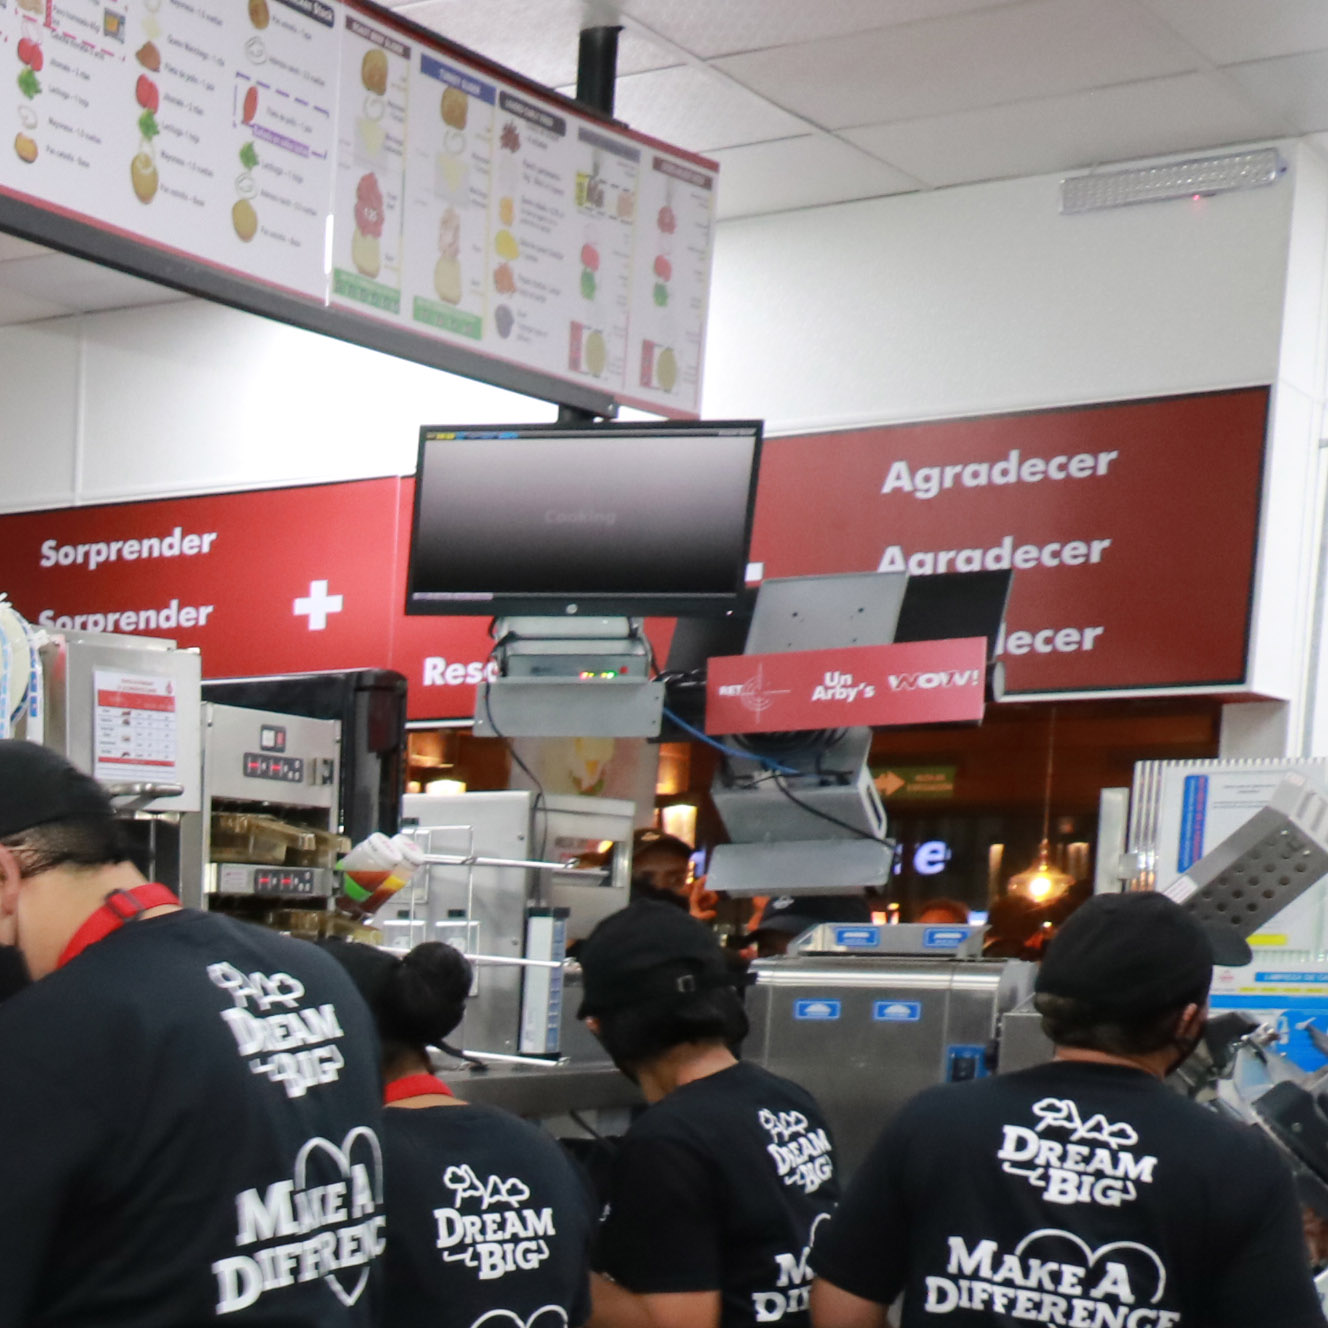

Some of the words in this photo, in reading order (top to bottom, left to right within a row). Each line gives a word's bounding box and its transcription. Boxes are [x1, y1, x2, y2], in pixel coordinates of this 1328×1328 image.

[882, 449, 1119, 499] Agradecer
[40, 527, 217, 570] Sorprender
[811, 682, 876, 704] Arby's
[824, 671, 854, 688] Un
[767, 1128, 833, 1177] DREAM
[998, 1123, 1159, 1184] DREAM
[350, 1163, 375, 1219] A
[1042, 1167, 1125, 1208] BIG
[432, 1207, 557, 1249] DREAM
[476, 1241, 542, 1281] BIG
[947, 1236, 1087, 1296] MAKE
[1090, 1261, 1136, 1305] A
